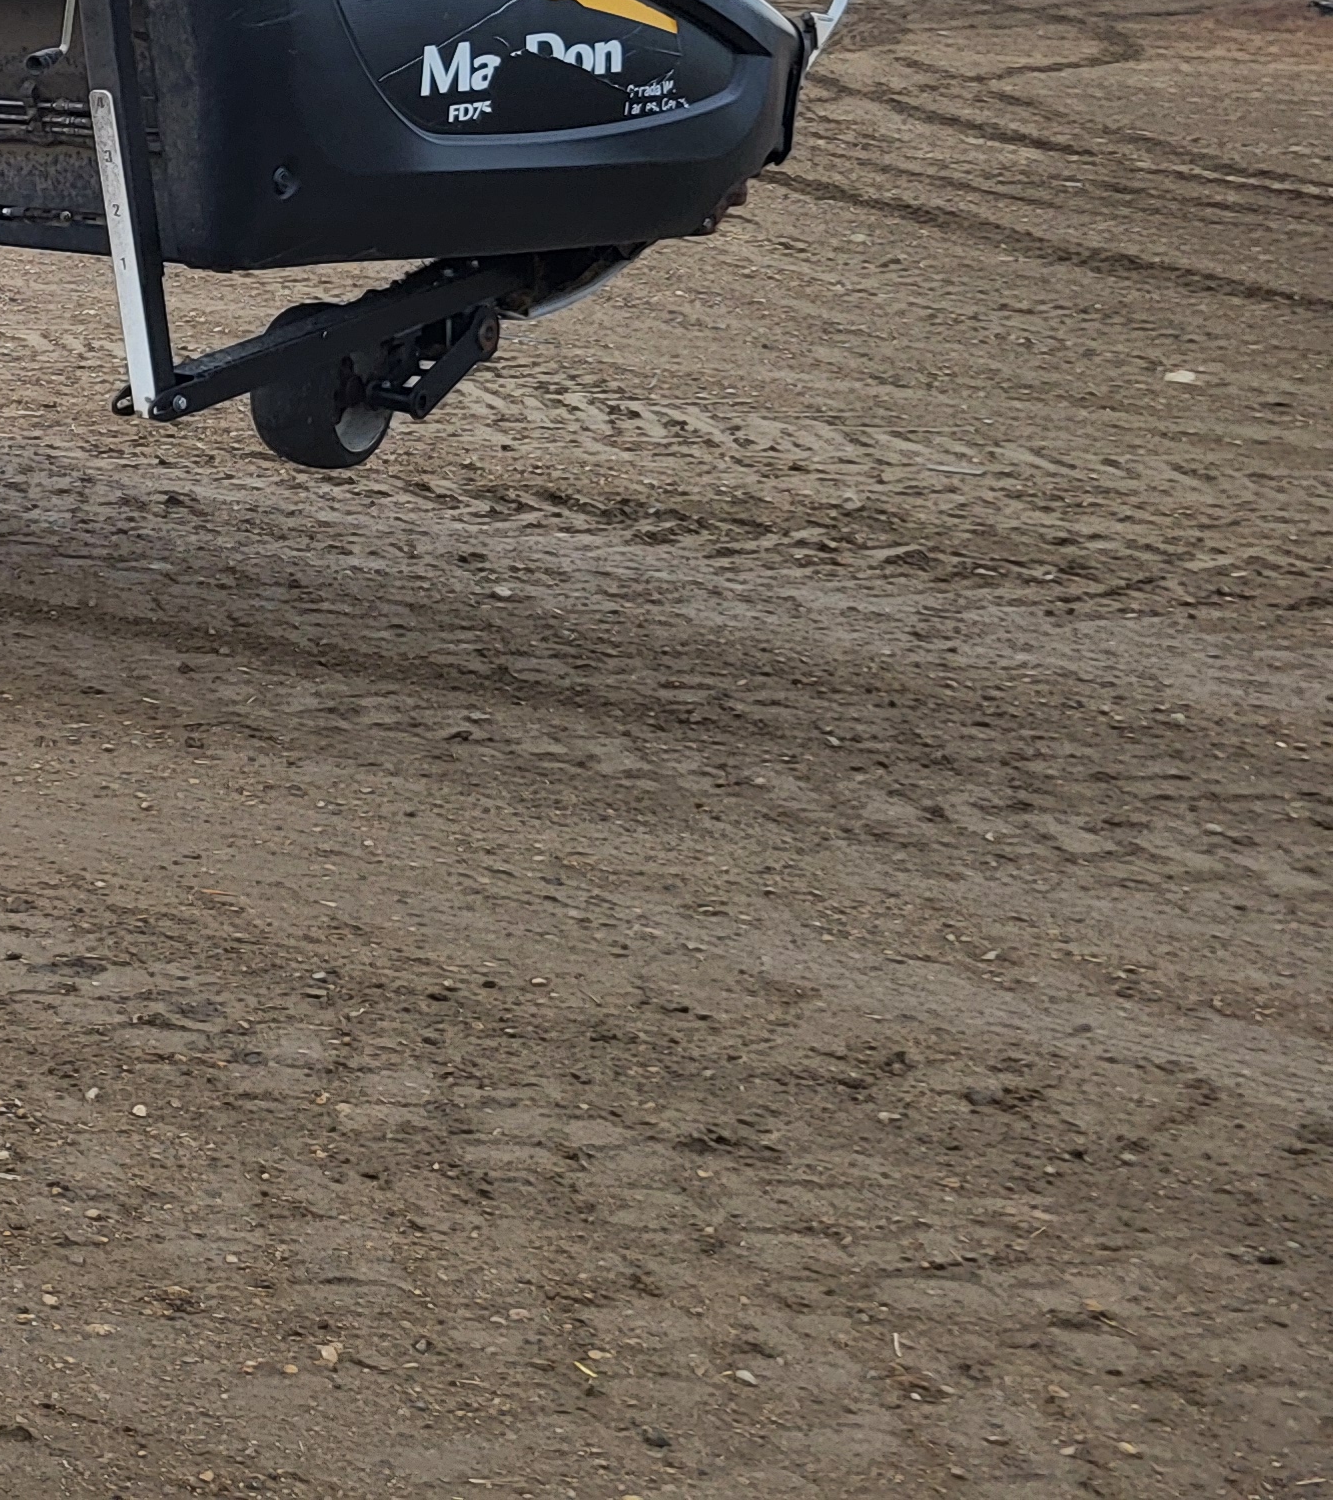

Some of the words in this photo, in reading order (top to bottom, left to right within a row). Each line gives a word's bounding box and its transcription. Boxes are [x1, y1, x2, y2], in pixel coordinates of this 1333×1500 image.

[420, 32, 623, 97] MaDon
[103, 150, 113, 163] 3
[112, 203, 121, 217] 2
[120, 257, 127, 271] 1
